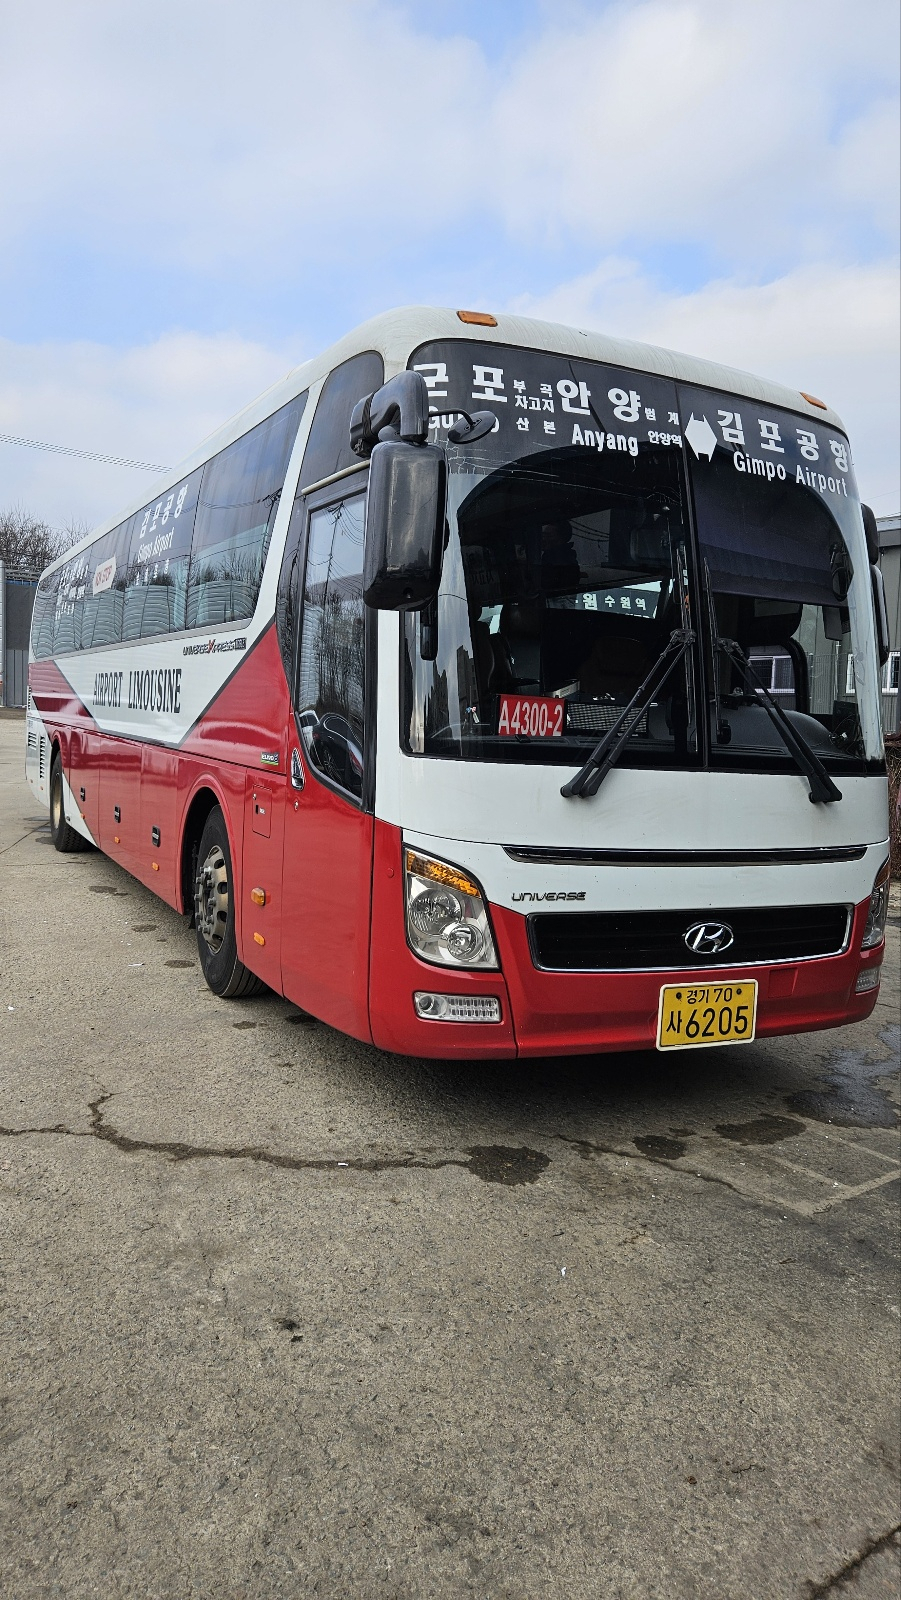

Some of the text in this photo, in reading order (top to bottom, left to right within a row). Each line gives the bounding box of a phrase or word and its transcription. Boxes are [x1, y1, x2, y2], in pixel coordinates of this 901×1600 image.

[513, 379, 553, 398] 부곡
[515, 395, 555, 413] 차고지
[556, 379, 642, 422] 안양
[516, 417, 556, 435] 산본
[645, 407, 680, 426] 범계
[572, 423, 638, 456] Anyang
[647, 430, 682, 448] 안양역
[717, 409, 849, 473] 김포공항
[733, 451, 848, 497] Gimpo Airport
[604, 595, 646, 611] 수원역
[93, 669, 182, 713] AIRPORT LIMOUSINE
[499, 700, 563, 737] A4300-2
[511, 891, 586, 902] UNIVERSE
